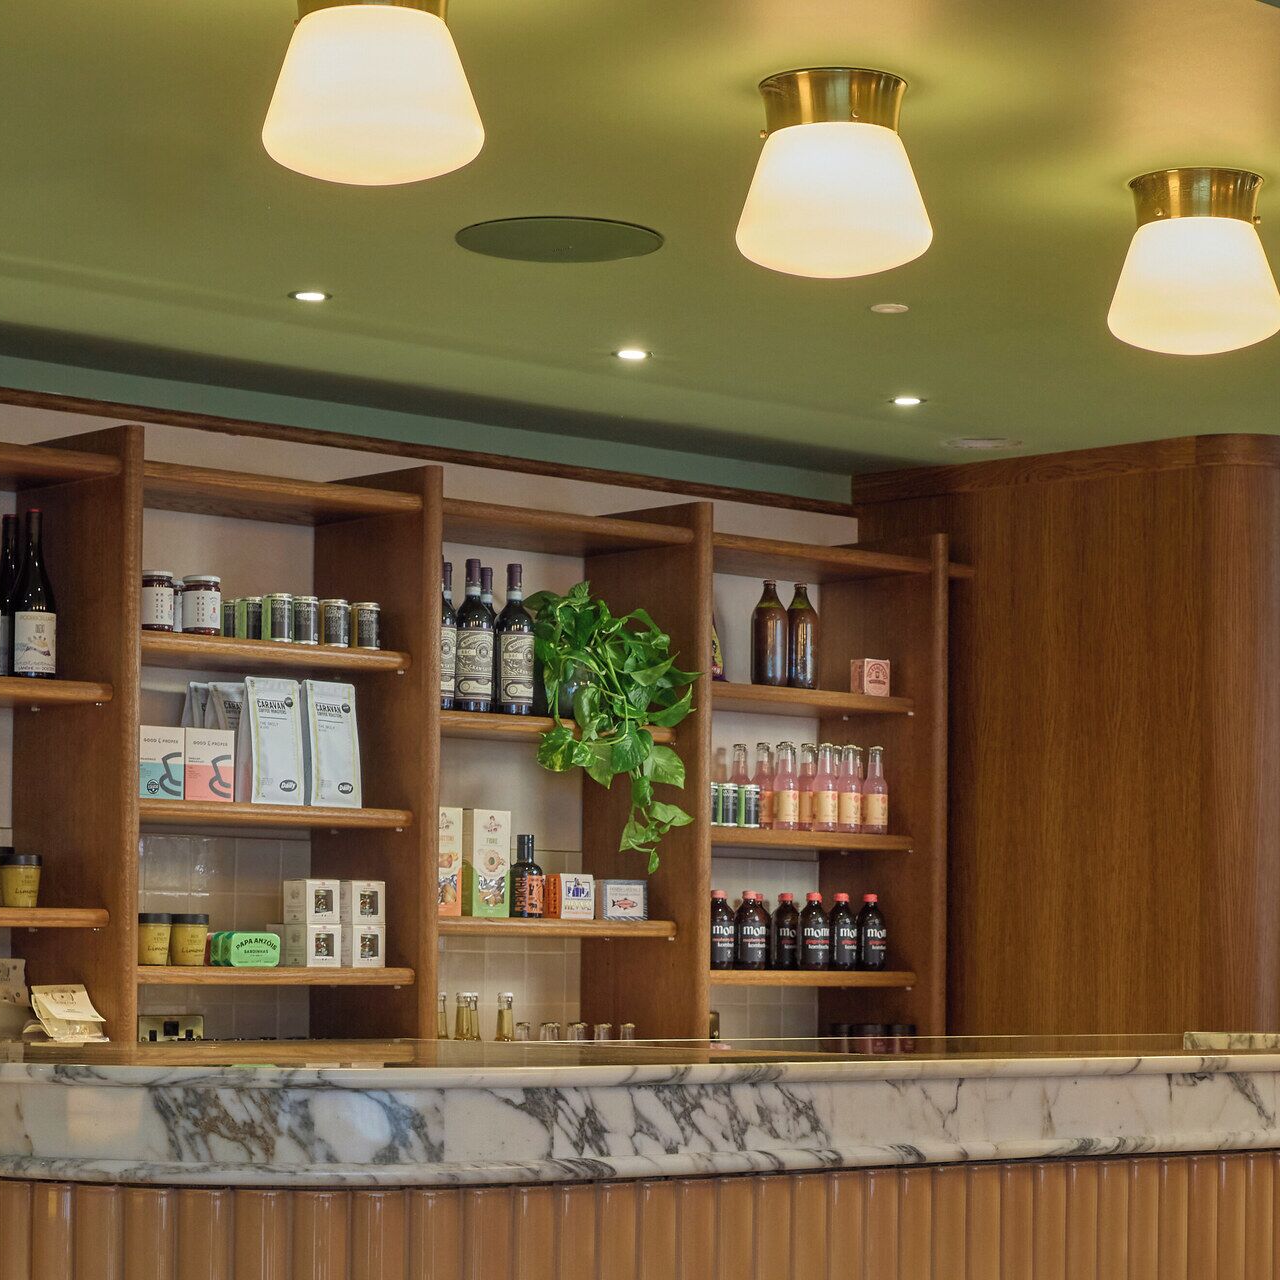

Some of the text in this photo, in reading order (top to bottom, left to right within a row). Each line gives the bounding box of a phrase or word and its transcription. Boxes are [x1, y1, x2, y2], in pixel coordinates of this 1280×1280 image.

[257, 699, 286, 710] CARAVAN
[315, 703, 342, 714] CARAVAN
[235, 938, 253, 951] PAPA
